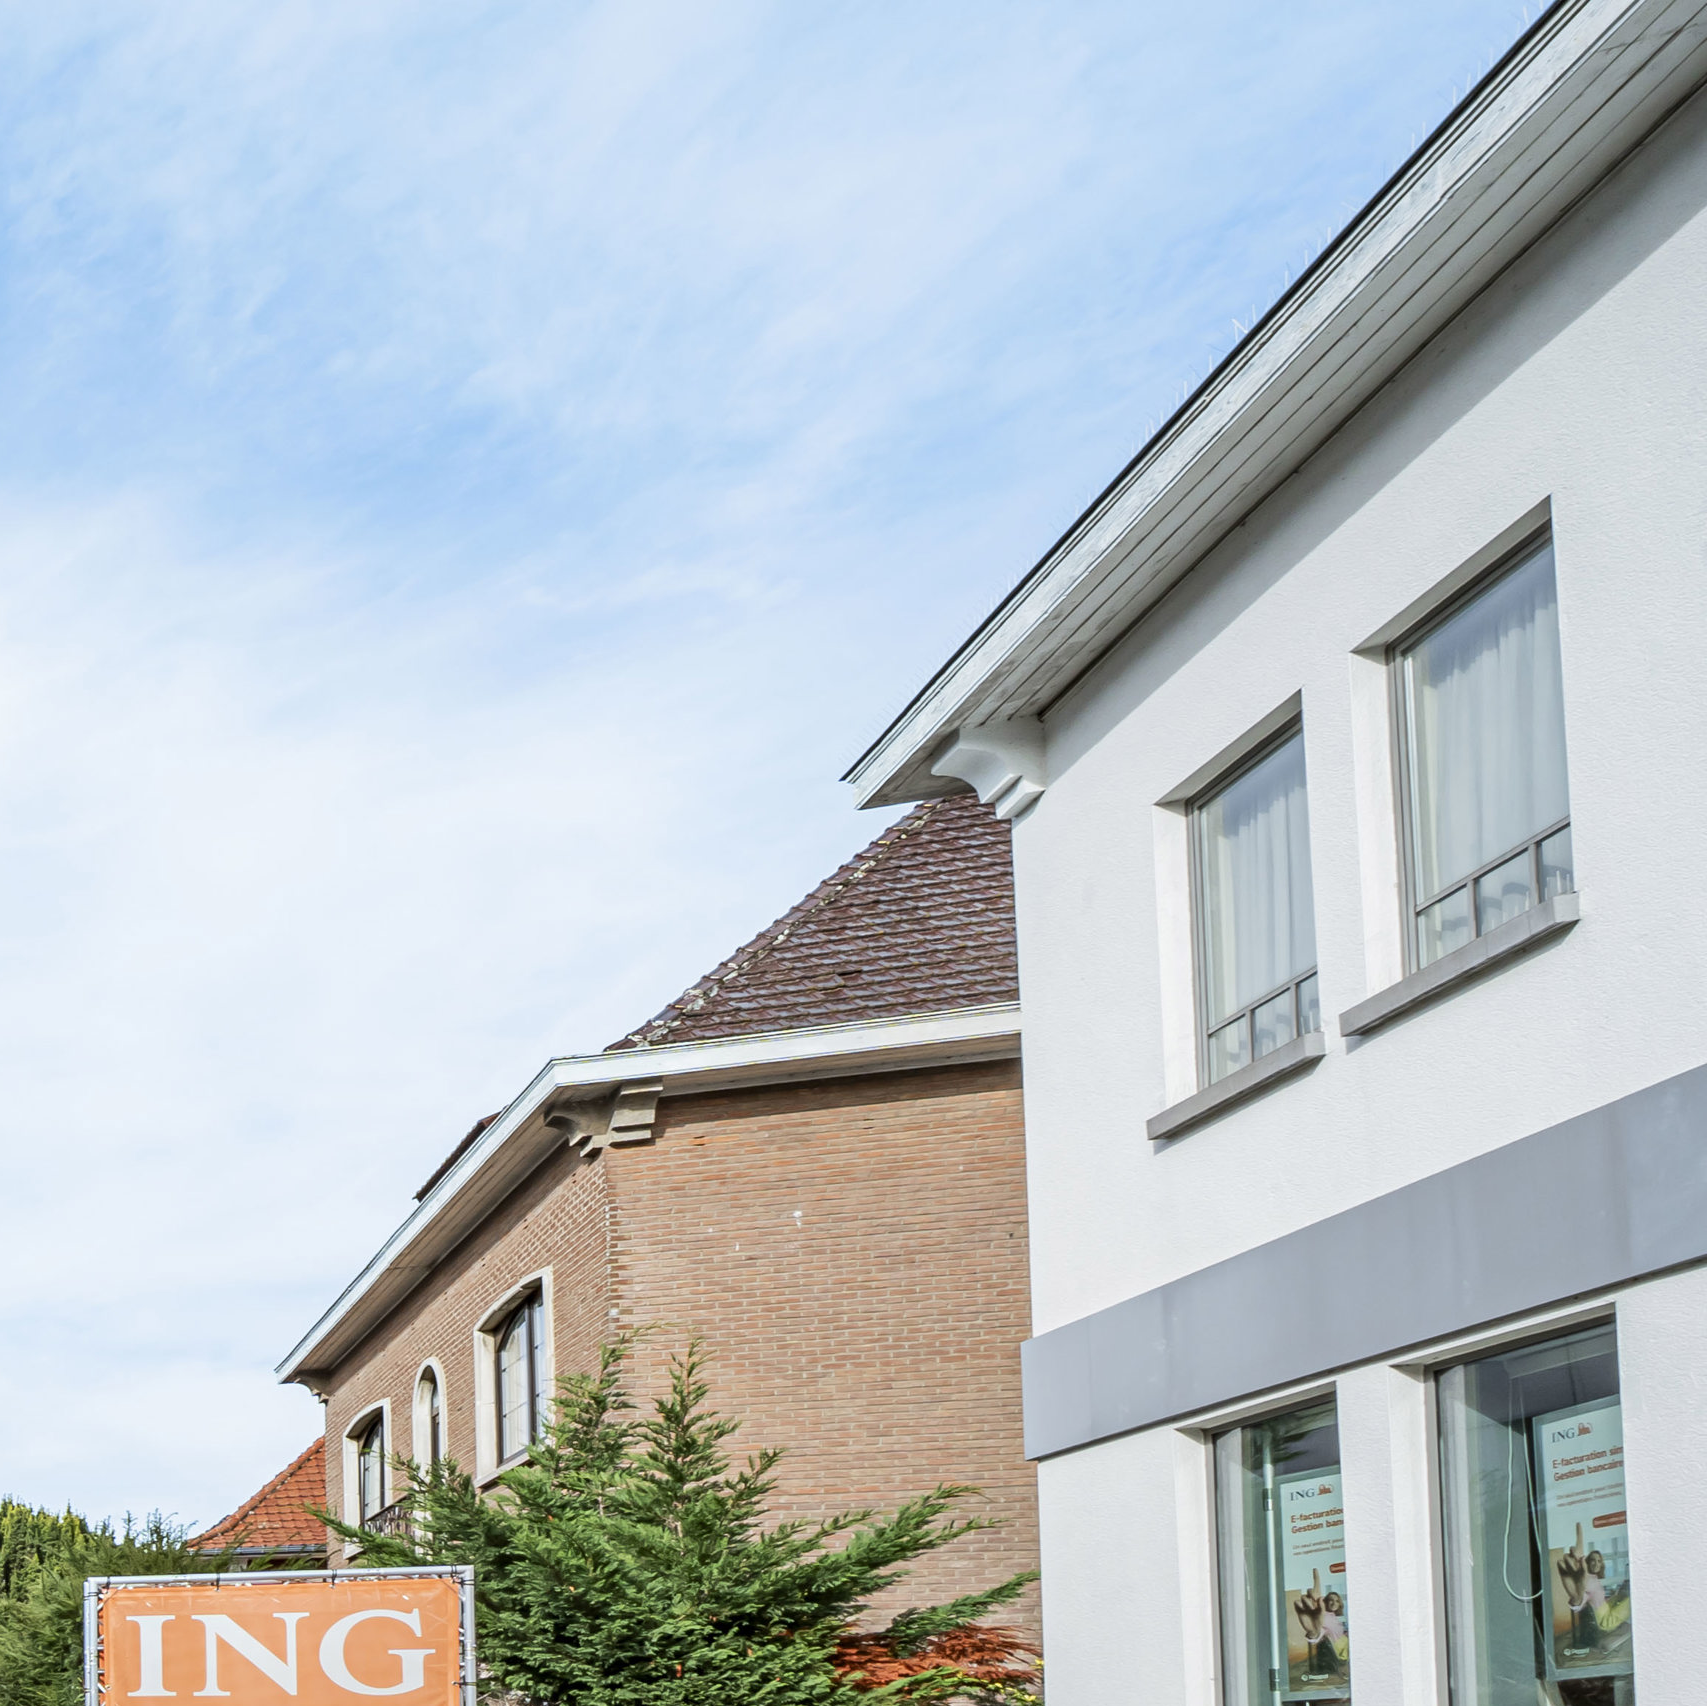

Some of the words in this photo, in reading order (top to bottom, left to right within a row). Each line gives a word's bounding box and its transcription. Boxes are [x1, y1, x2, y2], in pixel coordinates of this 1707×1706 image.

[1552, 1428, 1575, 1443] ING
[1552, 1450, 1607, 1469] E-facturation
[1553, 1468, 1585, 1481] Gestion
[1290, 1488, 1315, 1501] ING
[1292, 1522, 1323, 1534] Gestion
[126, 1608, 436, 1697] ING
